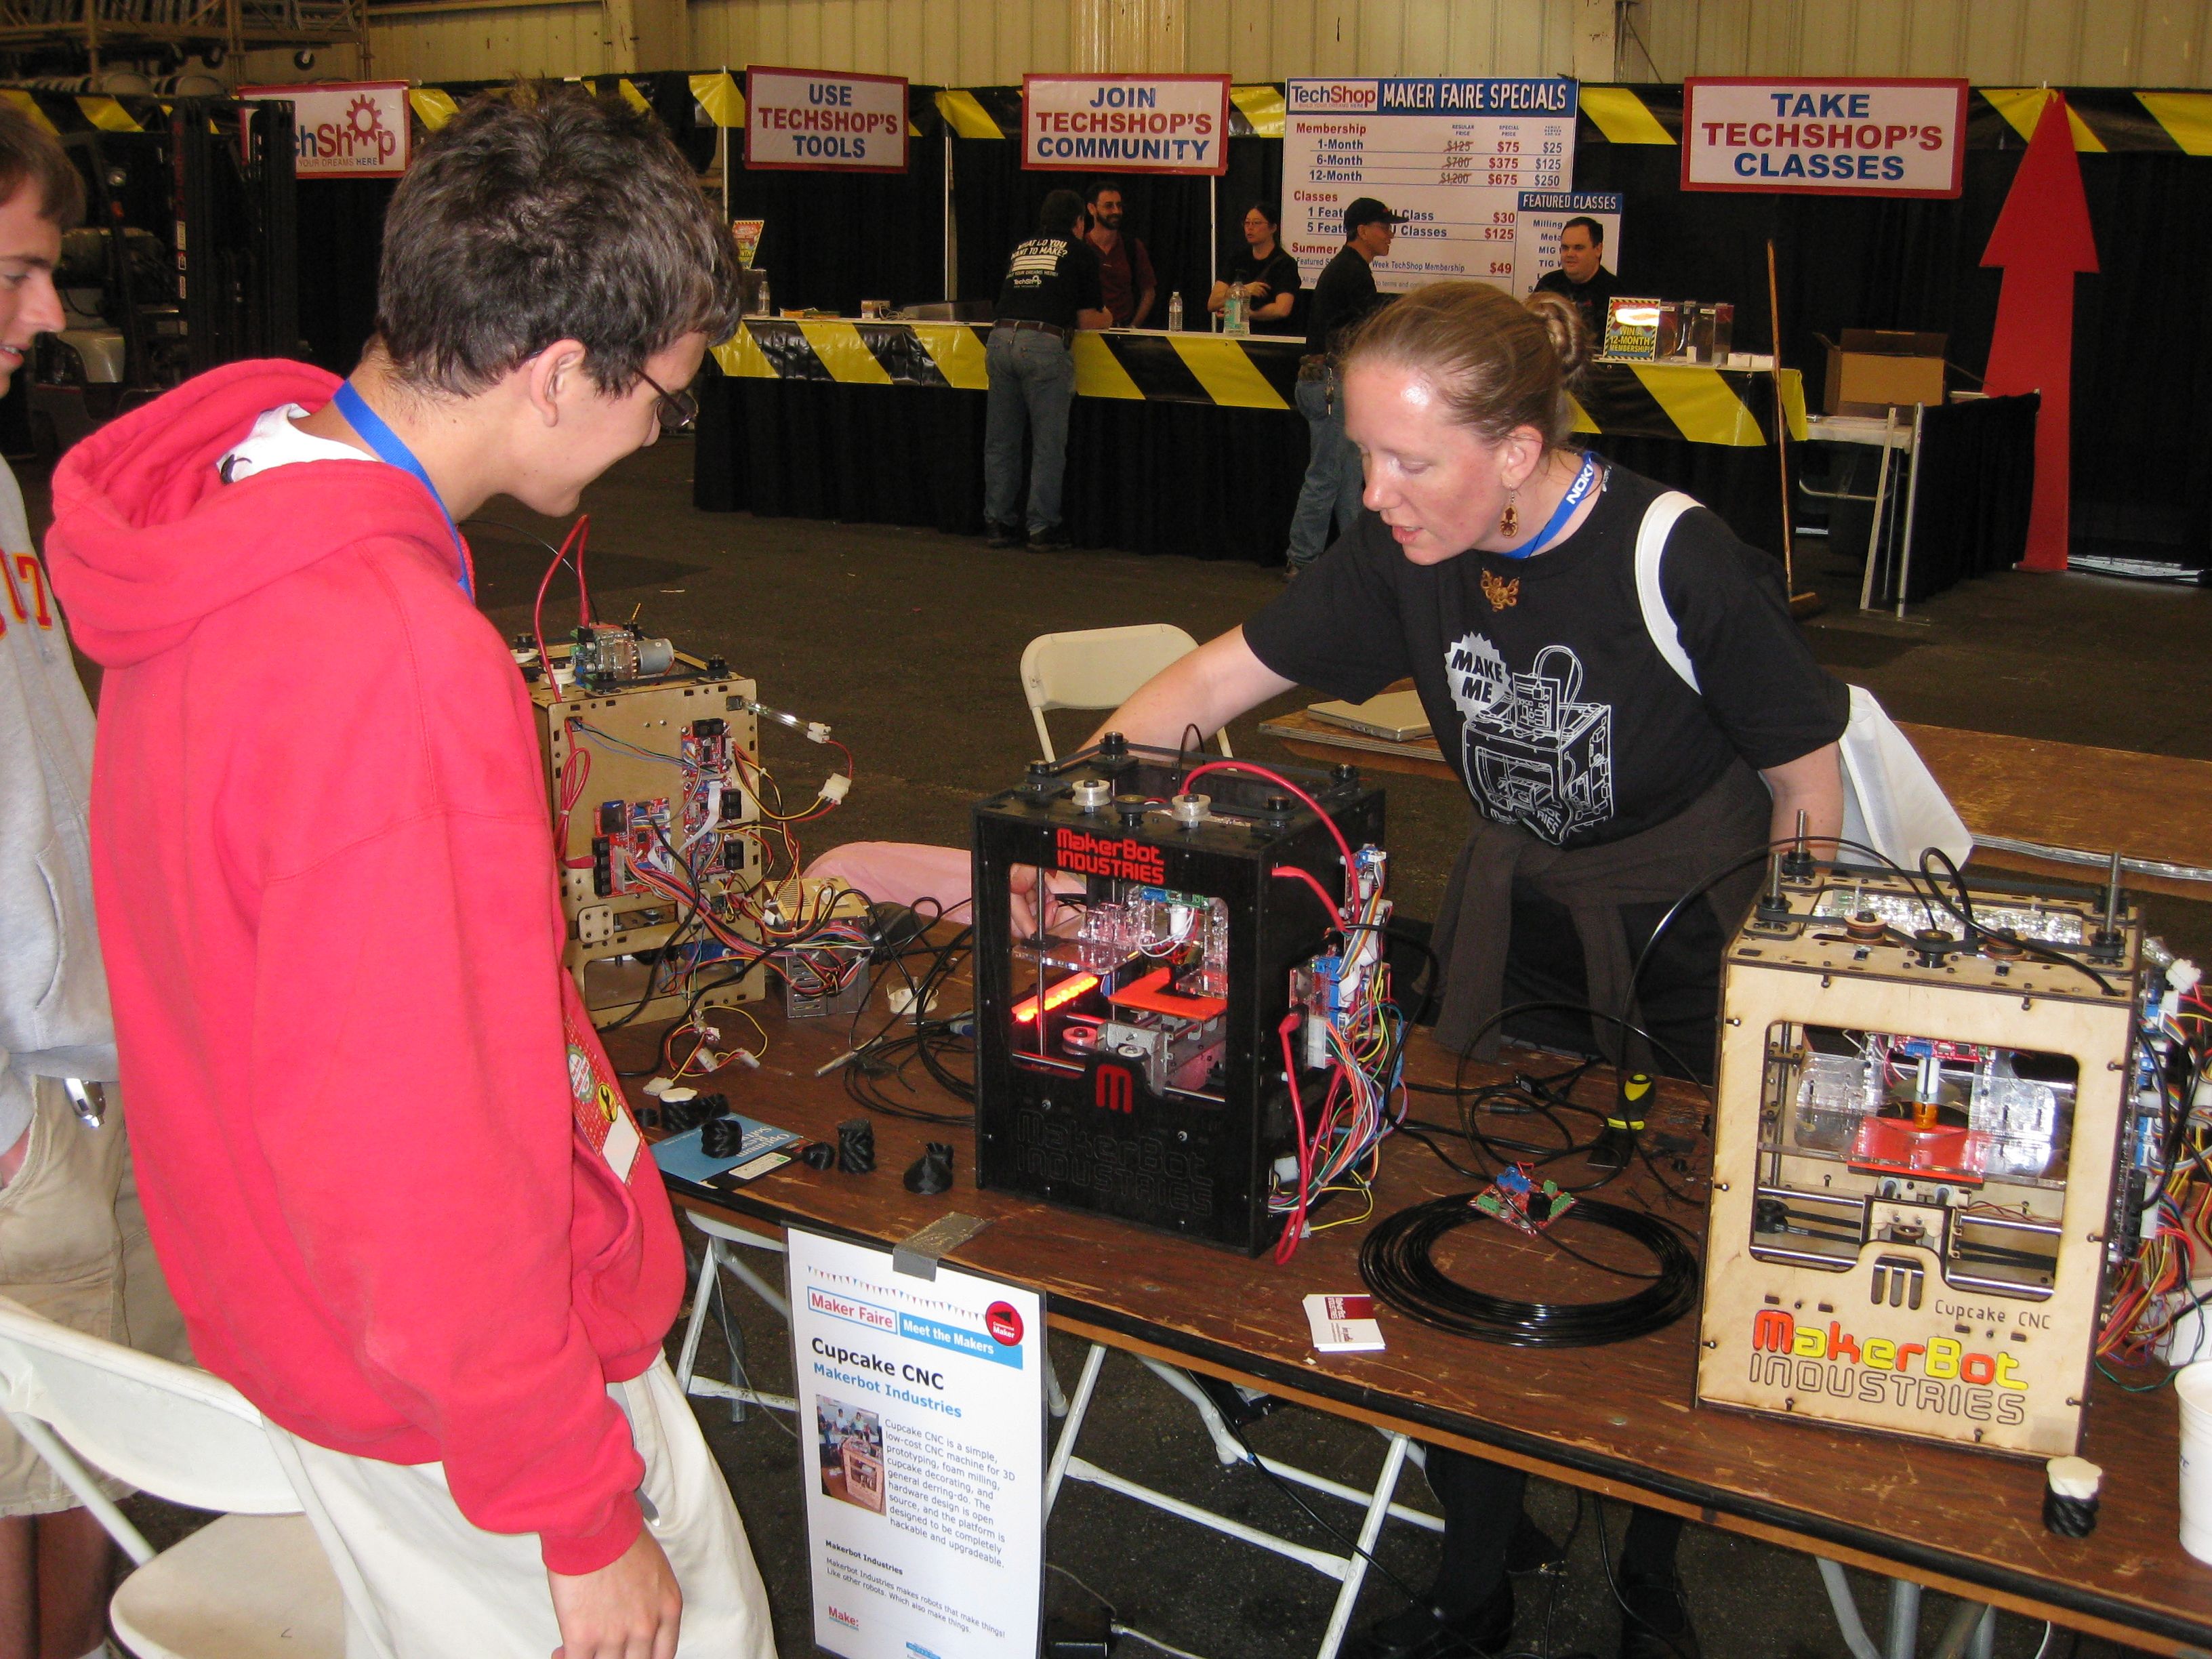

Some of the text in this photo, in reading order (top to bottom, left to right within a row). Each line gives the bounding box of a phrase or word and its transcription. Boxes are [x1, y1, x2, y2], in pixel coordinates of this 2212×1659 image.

[808, 83, 852, 107] USE
[1090, 87, 1156, 108] JOIN
[1291, 83, 1566, 110] TechShop MAKER FAIRE SPECIALS
[1770, 93, 1870, 119] TAKE
[758, 107, 898, 135] TECHSHOP'S
[1036, 112, 1212, 135] TECHSHOP'S
[1296, 123, 1367, 136] Membership
[792, 135, 866, 159] TOOLS
[1037, 137, 1210, 161] COMMUNITY
[1317, 139, 1562, 154] 1-Month $125 $75 $25
[1701, 122, 1943, 151] TECHSHOP'S
[322, 158, 354, 167] DREAMS
[356, 157, 377, 165] HERE
[1317, 155, 1561, 170] 6-Month $700 $375 $125
[1734, 152, 1905, 181] CLASSES
[1309, 170, 1362, 182] 12-Month
[1488, 173, 1517, 186] $675
[1534, 174, 1560, 186] $250
[1294, 190, 1616, 209] Classes FEATURED CLASSES
[1308, 207, 1313, 217] 1
[1493, 212, 1515, 224] $30
[1533, 220, 1563, 229] Milling
[1050, 239, 1067, 248] YOU
[1307, 222, 1313, 232] 5
[1401, 225, 1447, 237] Classes
[1484, 228, 1514, 241] $125
[1540, 233, 1561, 241] Meta
[1040, 247, 1068, 258] MAKE?
[1292, 242, 1338, 254] Summer
[1539, 246, 1556, 254] MIG
[1372, 260, 1389, 268] Week
[1391, 261, 1422, 271] TechShop
[1425, 262, 1465, 273] Membership
[1490, 262, 1512, 274] $49
[1610, 335, 1650, 346] 12-MONTH
[1620, 326, 1635, 335] WIN
[1566, 459, 1593, 504] NOKI
[1451, 649, 1504, 684] MAKE
[1461, 676, 1495, 704] ME
[1057, 828, 1164, 865] MakerBot
[812, 1292, 893, 1328] Maker Faire
[1935, 1298, 2051, 1330] Cupcake CNC
[903, 1319, 994, 1355] Meet the Makers
[993, 1326, 1015, 1338] Maker
[812, 1337, 944, 1390] Cupcake CNC
[1753, 1309, 2029, 1391] MakerBot
[813, 1361, 962, 1418] Makerbot Industries
[885, 1418, 922, 1437] Cupcake
[925, 1431, 944, 1445] CNC
[947, 1438, 954, 1448] is
[965, 1446, 998, 1464] simple,
[886, 1431, 1015, 1481] low-cost CNC machine for 3D
[886, 1446, 1000, 1491] prototyping, foam milling,
[887, 1458, 994, 1500] cupcake decorating, and
[888, 1470, 991, 1511] general derring-do. The
[888, 1480, 994, 1525] hardware design is open
[889, 1494, 1005, 1543] source, and the platform is
[890, 1506, 1002, 1555] designed to be completely
[890, 1517, 1004, 1568] hackable and upgradeable.
[825, 1540, 903, 1575] Makerbot Industries
[827, 1557, 1006, 1638] Makerbot Industries makes robots that make things!
[827, 1567, 971, 1633] Like other robots. Which also make things.
[828, 1605, 859, 1627] Make:
